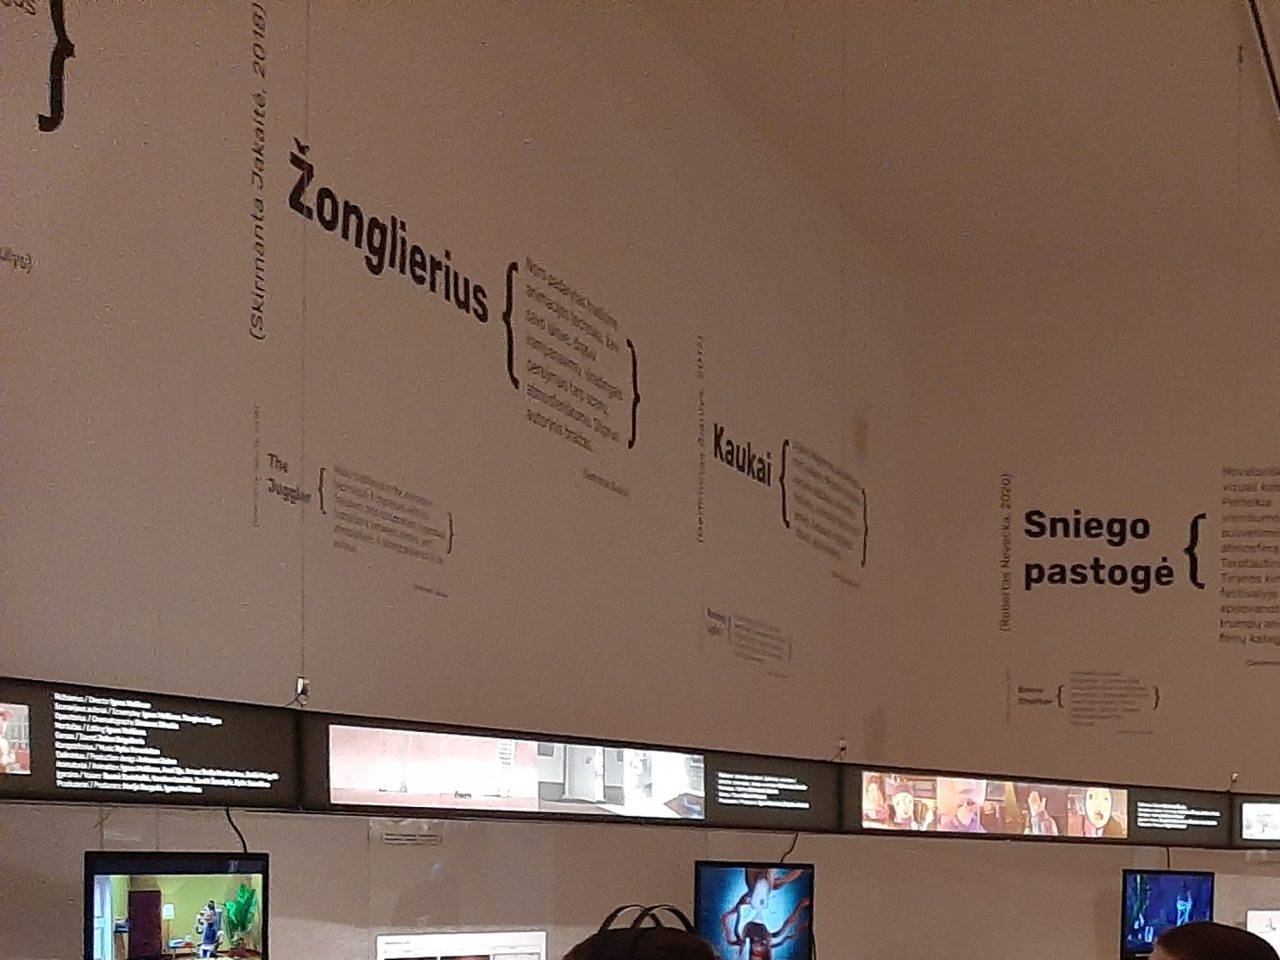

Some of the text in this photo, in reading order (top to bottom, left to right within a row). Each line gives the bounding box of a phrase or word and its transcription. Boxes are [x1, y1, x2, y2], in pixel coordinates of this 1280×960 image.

[288, 137, 490, 324] Žonglierius
[249, 197, 266, 341] (Skirmanta
[713, 423, 772, 487] Kaukai
[1024, 508, 1152, 547] Sniego
[1024, 557, 1175, 594] pastogė
